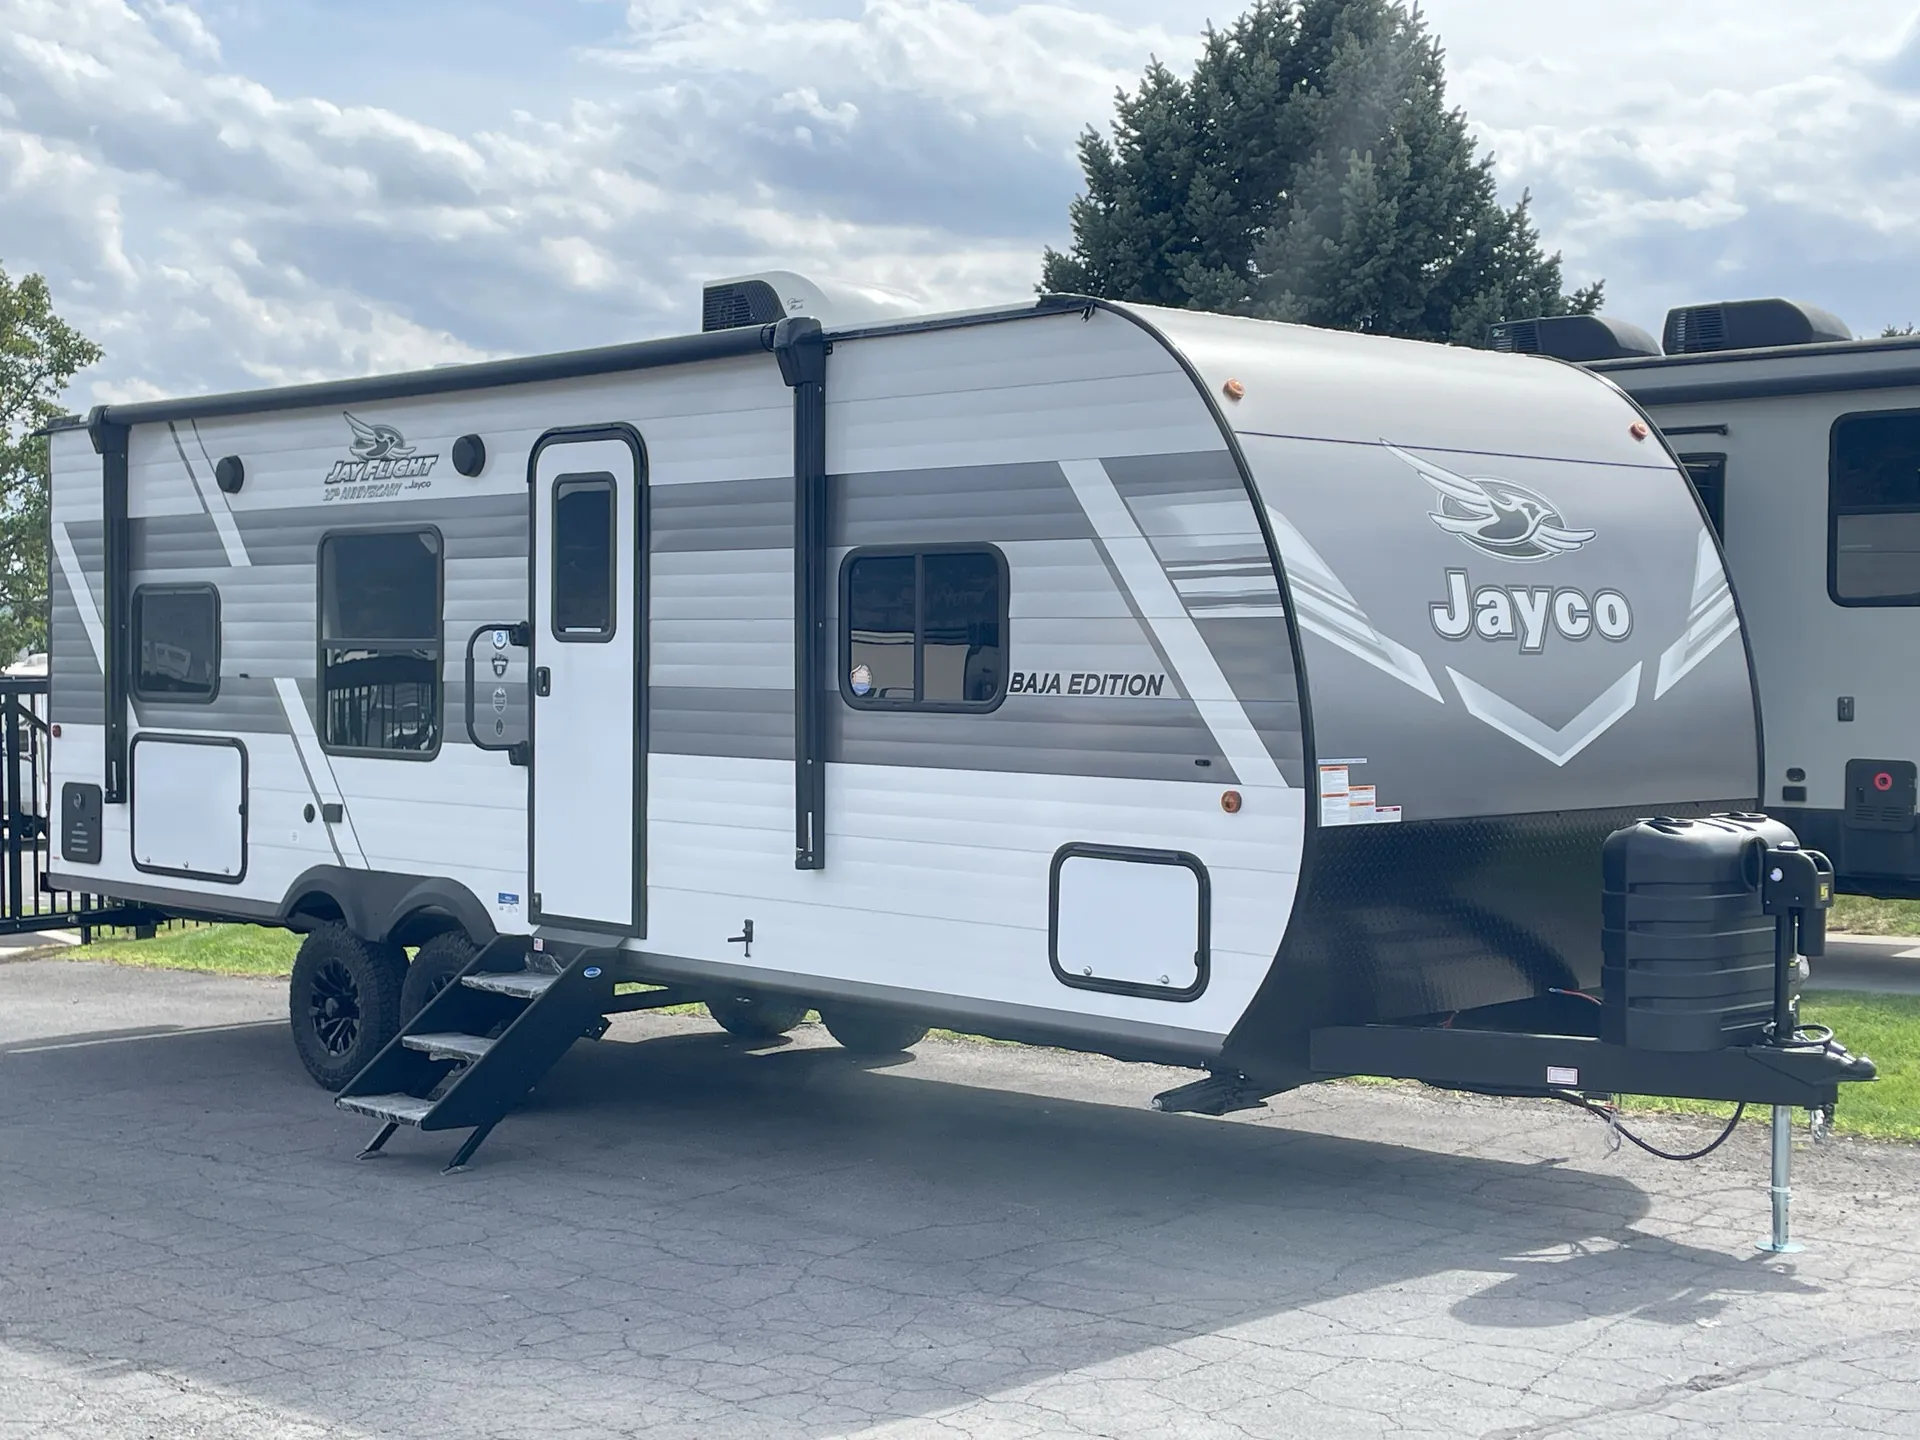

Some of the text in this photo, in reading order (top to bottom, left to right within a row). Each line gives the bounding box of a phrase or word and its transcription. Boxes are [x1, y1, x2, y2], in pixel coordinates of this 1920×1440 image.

[1428, 567, 1633, 654] Jayco
[1009, 672, 1164, 696] BAJA EDITION
